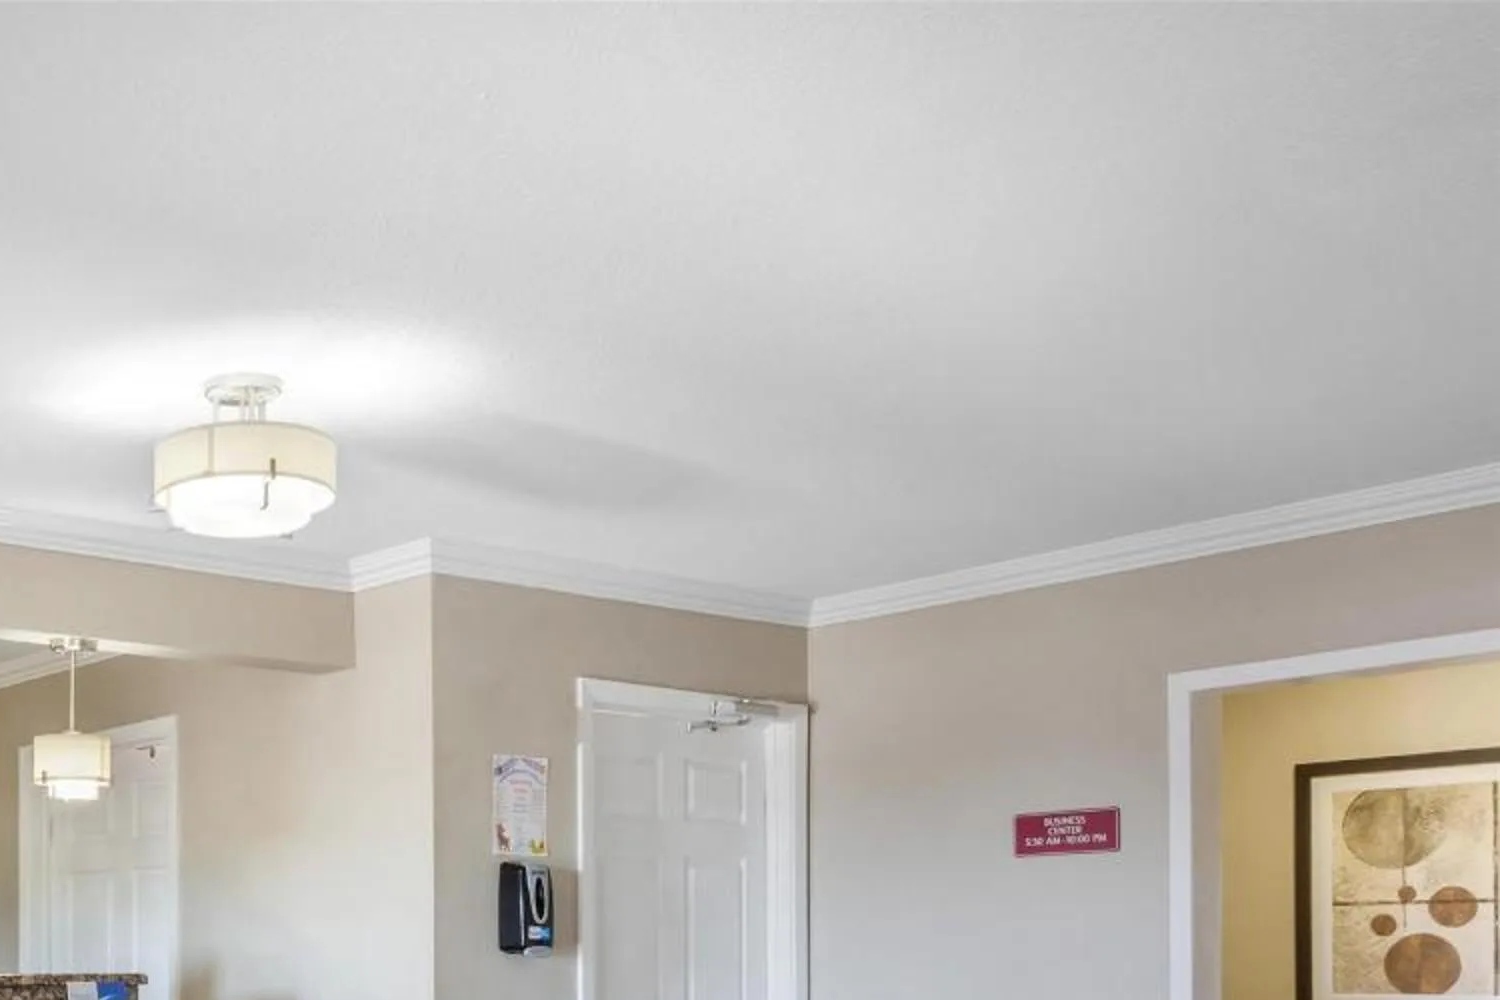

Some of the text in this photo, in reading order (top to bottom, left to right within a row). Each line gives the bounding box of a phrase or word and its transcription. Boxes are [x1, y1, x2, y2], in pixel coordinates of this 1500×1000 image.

[1044, 816, 1086, 827] BUSINESS
[1047, 826, 1083, 835] CENTER
[1092, 833, 1108, 842] PM
